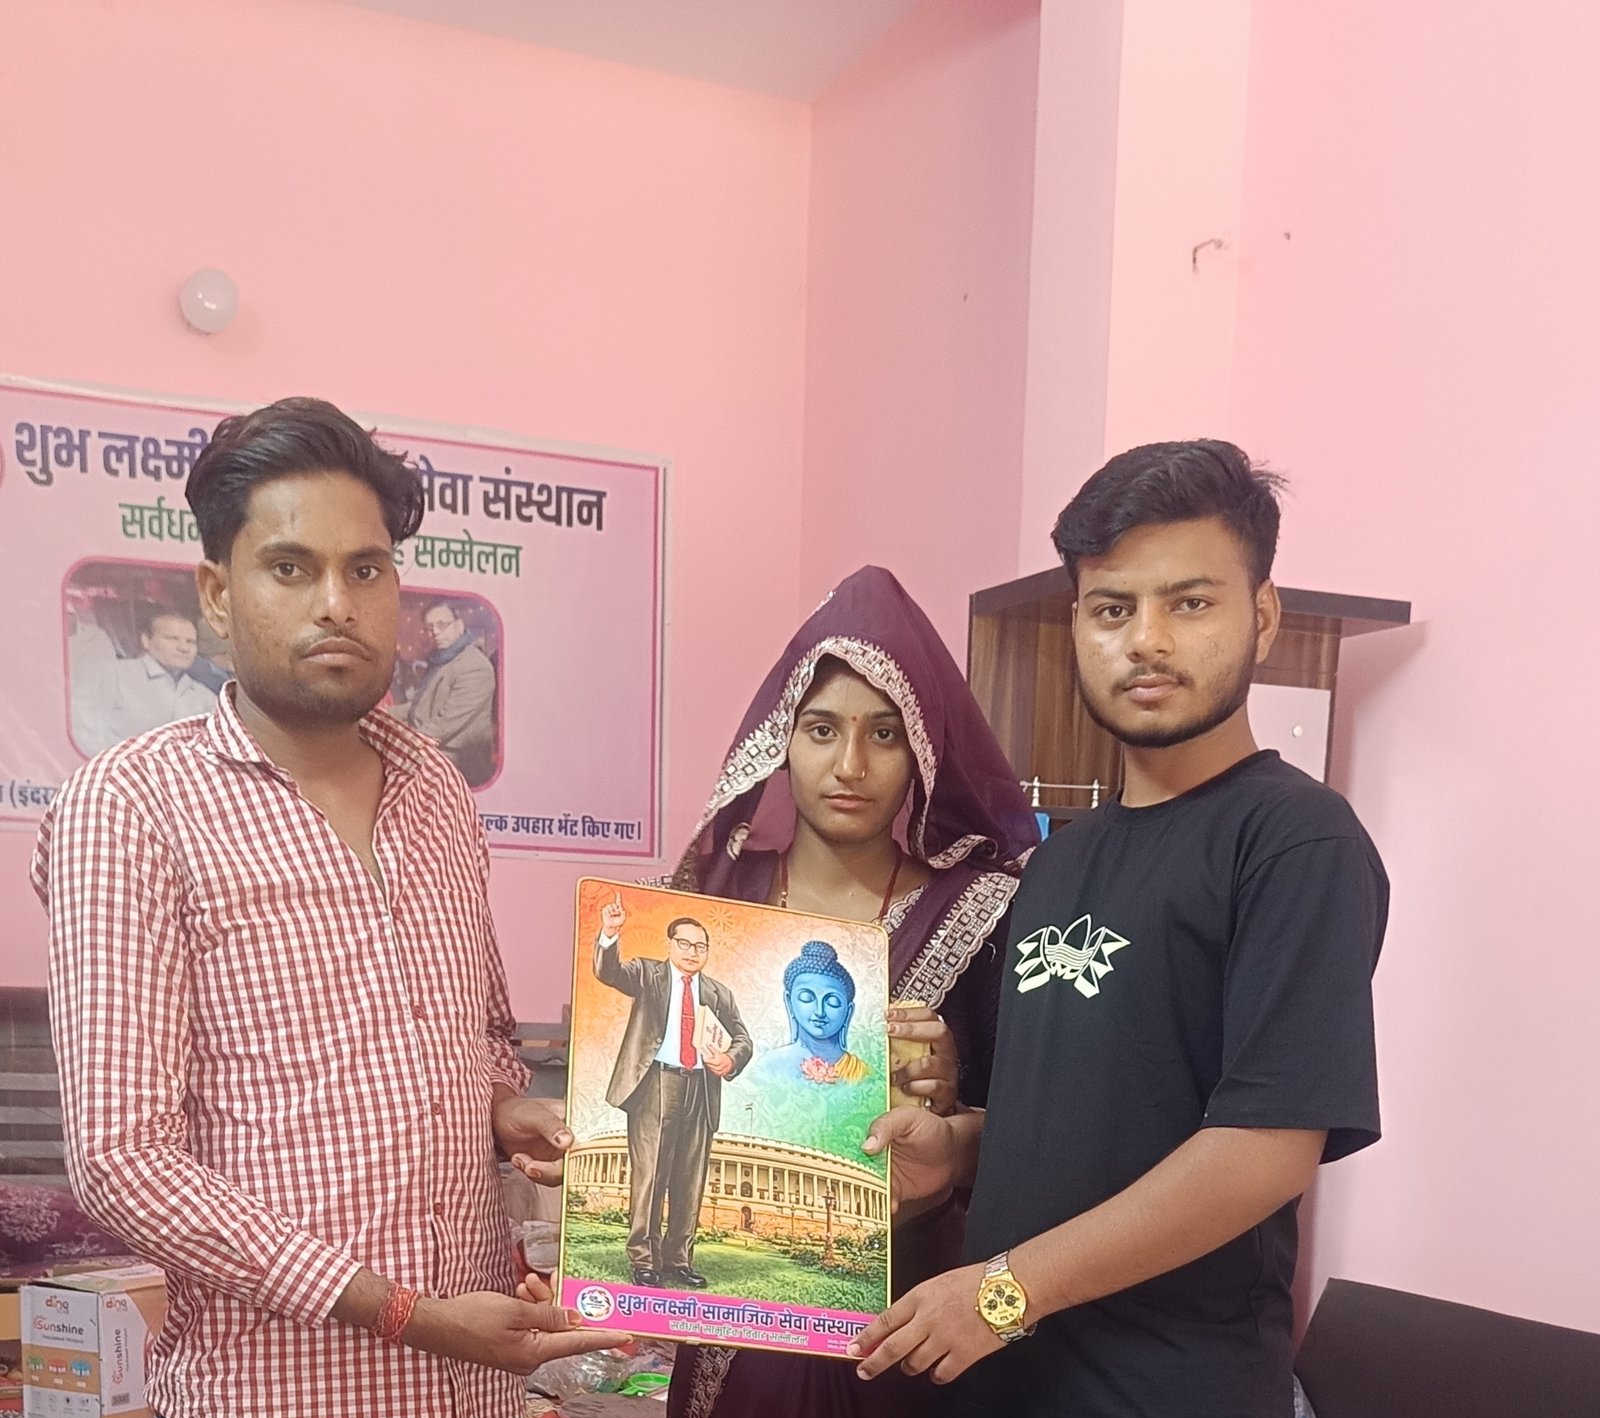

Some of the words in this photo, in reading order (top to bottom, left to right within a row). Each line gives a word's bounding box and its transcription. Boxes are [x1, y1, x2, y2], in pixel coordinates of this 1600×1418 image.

[15, 422, 91, 486] शुभ
[479, 466, 607, 531] संस्थान
[511, 815, 554, 836] उपहार
[557, 812, 579, 836] भेंट
[581, 815, 611, 839] किए
[37, 1319, 84, 1336] Sunshine
[618, 1294, 648, 1316] शुभ
[652, 1297, 698, 1318] लक्ष्मी
[701, 1303, 775, 1327] सामाजिक
[778, 1309, 807, 1331] सेवा
[114, 1328, 123, 1385] Sunshine
